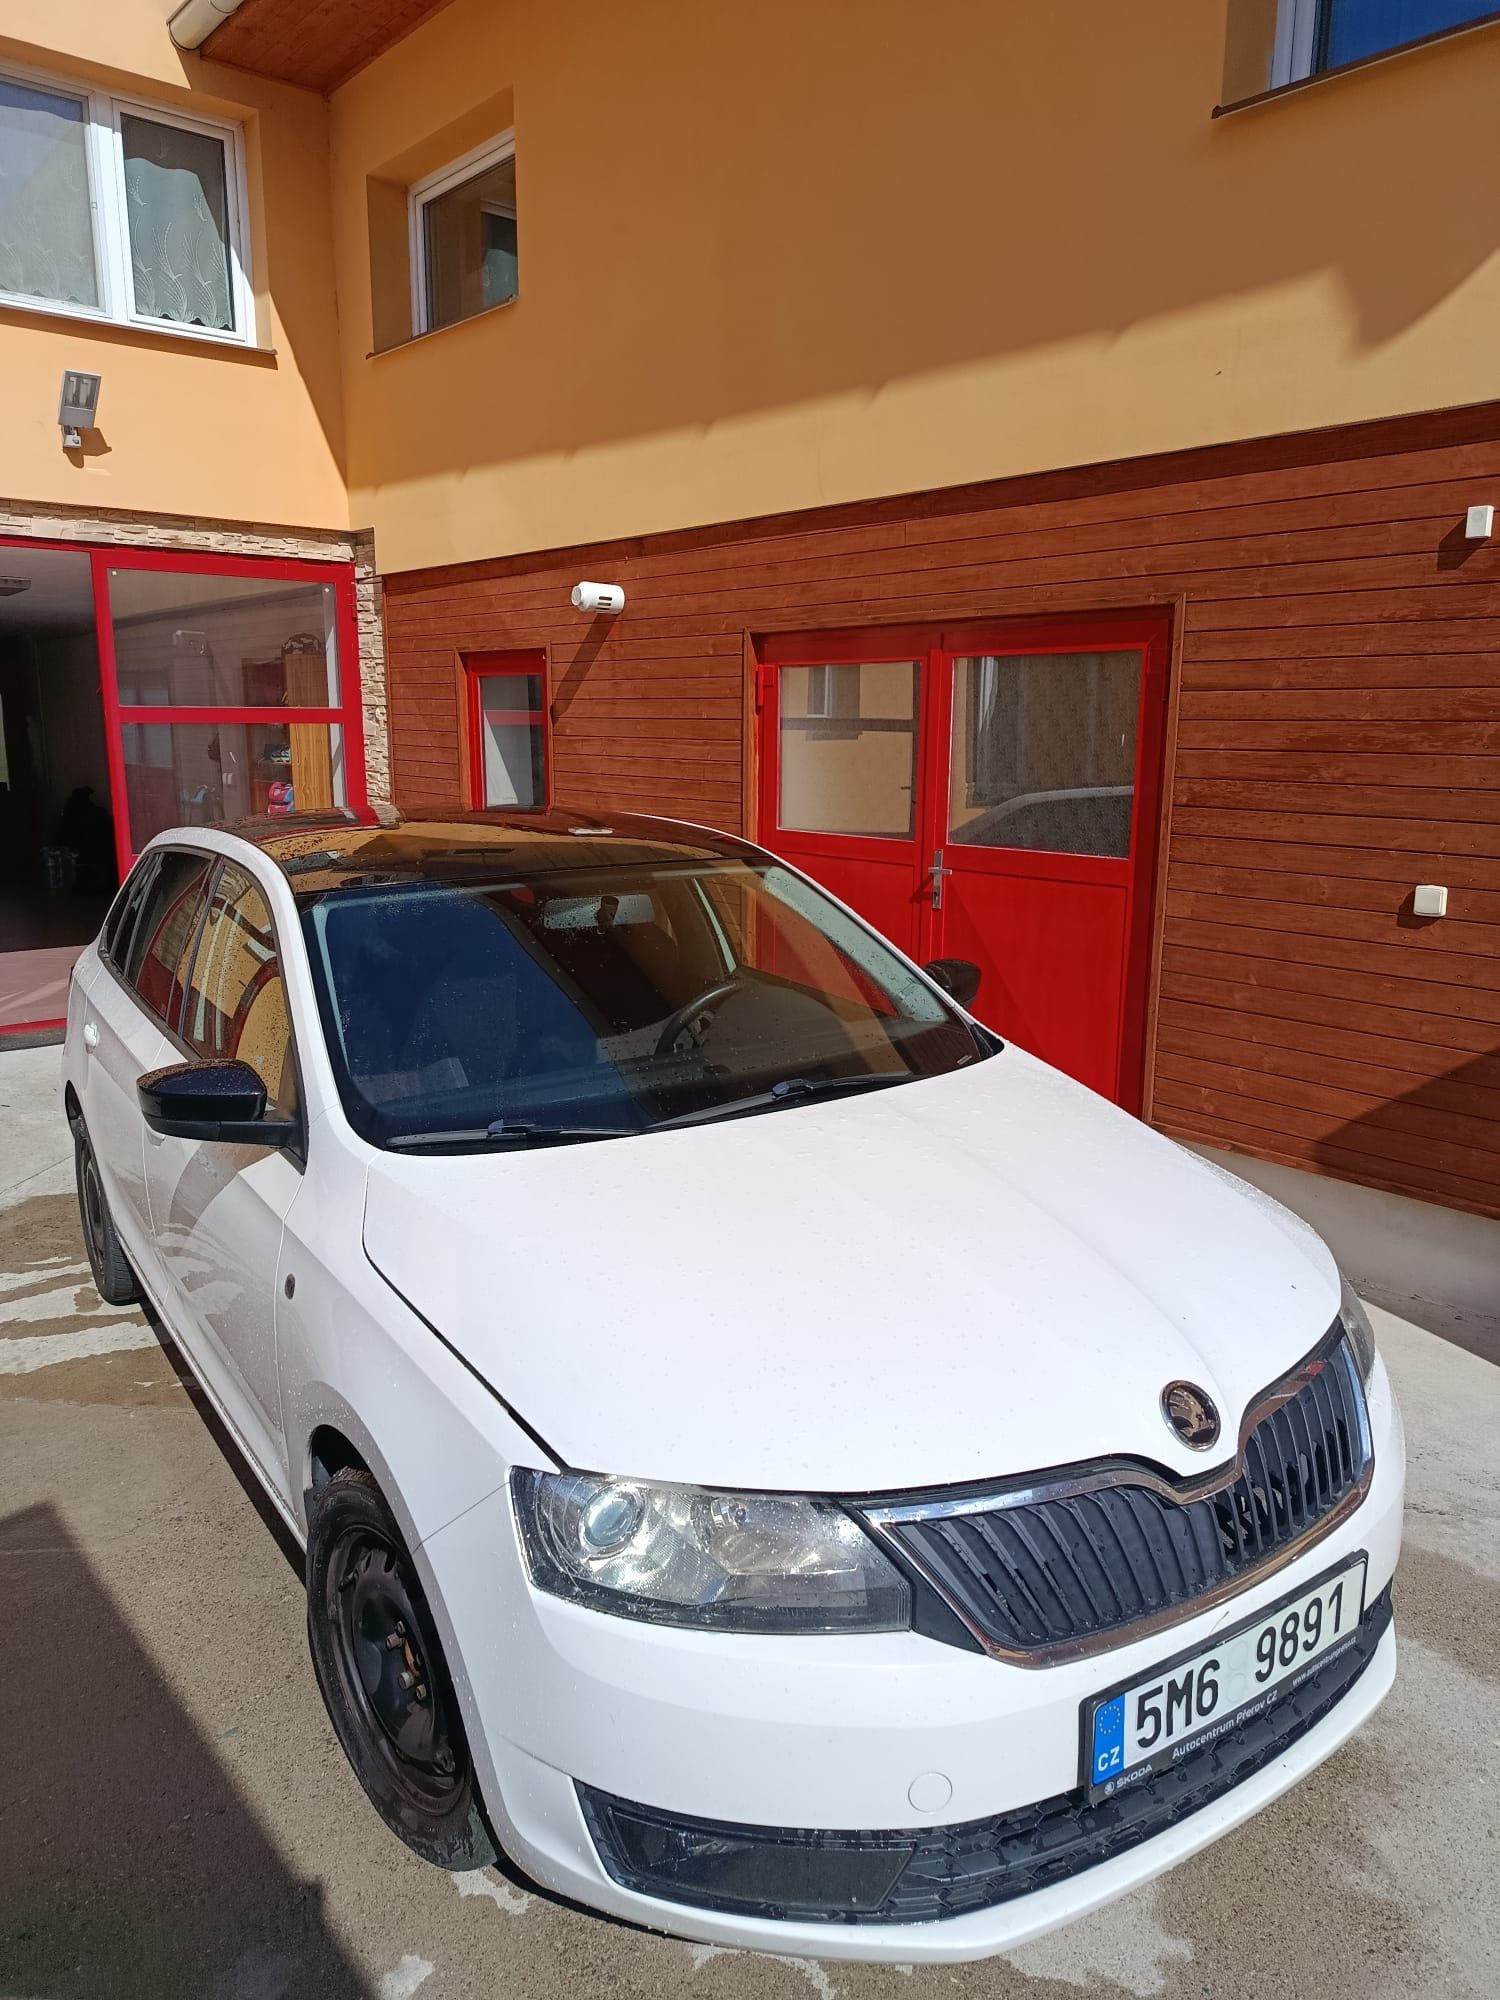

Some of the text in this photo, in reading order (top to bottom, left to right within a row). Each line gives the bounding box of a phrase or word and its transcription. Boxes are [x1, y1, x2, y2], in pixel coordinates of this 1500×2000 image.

[1136, 1581, 1344, 1748] 5M6 9891
[1172, 1690, 1278, 1759] Autocentrum Přerov CZ
[1098, 1746, 1120, 1771] CZ
[1116, 1764, 1153, 1788] ŠKODA
